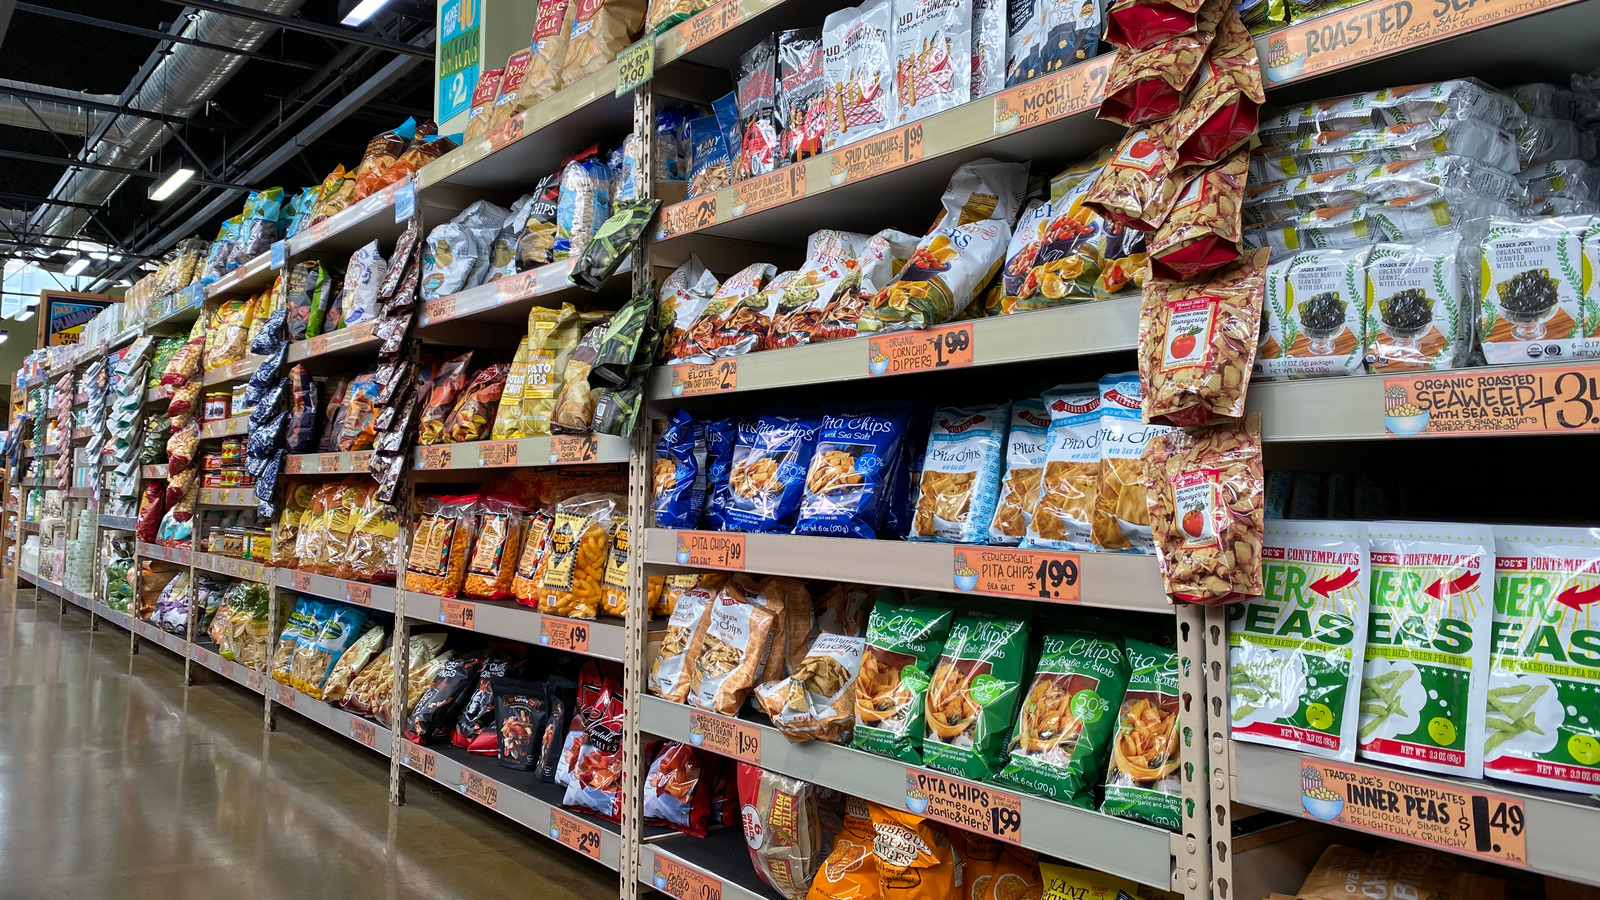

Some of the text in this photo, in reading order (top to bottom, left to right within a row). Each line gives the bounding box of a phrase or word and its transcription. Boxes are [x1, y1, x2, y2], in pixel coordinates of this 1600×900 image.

[537, 17, 558, 32] Cut
[692, 11, 714, 30] VEGGIE
[1304, 1, 1413, 57] ROASTED
[1373, 8, 1470, 46] WITH SEA SALT
[1401, 2, 1536, 45] CRUNCH AND DELICIOUS NUTTY
[690, 19, 716, 43] STICKS
[620, 50, 650, 75] OKRA
[1017, 68, 1084, 99] CRISPY CRUNCHY
[1023, 84, 1071, 113] MOCHI
[1019, 96, 1087, 127] RICE NUGGETS
[844, 147, 861, 166] SPUD
[863, 134, 899, 160] CRUNCHIES
[684, 220, 697, 233] MIX
[1495, 245, 1552, 256] ORGANIC ROASTED
[1495, 254, 1525, 263] SEAWEED
[1516, 260, 1528, 268] SEA
[1528, 259, 1544, 267] SALT
[889, 335, 915, 349] ORGANIC
[892, 344, 928, 359] CORN CHIP
[893, 355, 932, 371] DIPPERS
[688, 369, 713, 380] ELOTE
[1413, 374, 1536, 391] ORGANIC ROASTED
[1415, 385, 1536, 411] SEAWEED
[1429, 405, 1526, 420] WITH SEA SALT
[848, 416, 892, 436] Chips
[1429, 418, 1472, 428] DELICIOUS
[1474, 418, 1503, 426] SNACK
[838, 431, 871, 441] Sea Salt
[1060, 437, 1085, 450] Pita
[932, 446, 982, 464] Pita Chips
[1012, 442, 1035, 455] Pita
[1121, 447, 1133, 455] Sea
[859, 455, 884, 469] 50%
[691, 536, 708, 551] PITA
[709, 537, 731, 552] CHIPS
[1287, 547, 1360, 566] CONTEMPLATES
[1403, 553, 1480, 569] CONTEMPLATES
[1498, 559, 1523, 568] JOE'S
[982, 563, 1005, 579] PITA
[1006, 564, 1035, 580] CHIPS
[986, 582, 1016, 592] SEA SALT
[1368, 613, 1474, 655] EAS
[1068, 638, 1122, 665] Chips
[1410, 650, 1468, 667] GREEN PEA SNACK
[1091, 664, 1115, 678] Herb
[1544, 664, 1586, 677] GREEN PEA
[1077, 693, 1110, 712] 50%
[696, 713, 737, 731] REDUCED GUILT
[700, 721, 733, 738] MULTIGRAIN
[703, 732, 731, 748] PITA CHIPS
[1280, 728, 1293, 738] NET
[1400, 745, 1415, 756] NET
[1429, 750, 1438, 760] 3.3
[1438, 751, 1446, 761] OZ
[1536, 763, 1551, 775] NET
[1570, 768, 1580, 779] 3.3
[1581, 770, 1591, 780] OZ
[917, 774, 989, 808] PITA CHIPS
[1323, 768, 1466, 805] TRADER JOE'S CONTEMPLATES
[773, 793, 784, 827] POTATO
[782, 795, 793, 827] KETTLE
[928, 794, 984, 820] Parmesan,
[1346, 783, 1400, 814] INNER
[1404, 795, 1450, 825] PEAS
[1349, 805, 1459, 837] DELICIOUSLY SIMPLE &
[1350, 815, 1467, 848] DELIGHTFULLY CRUNCHY
